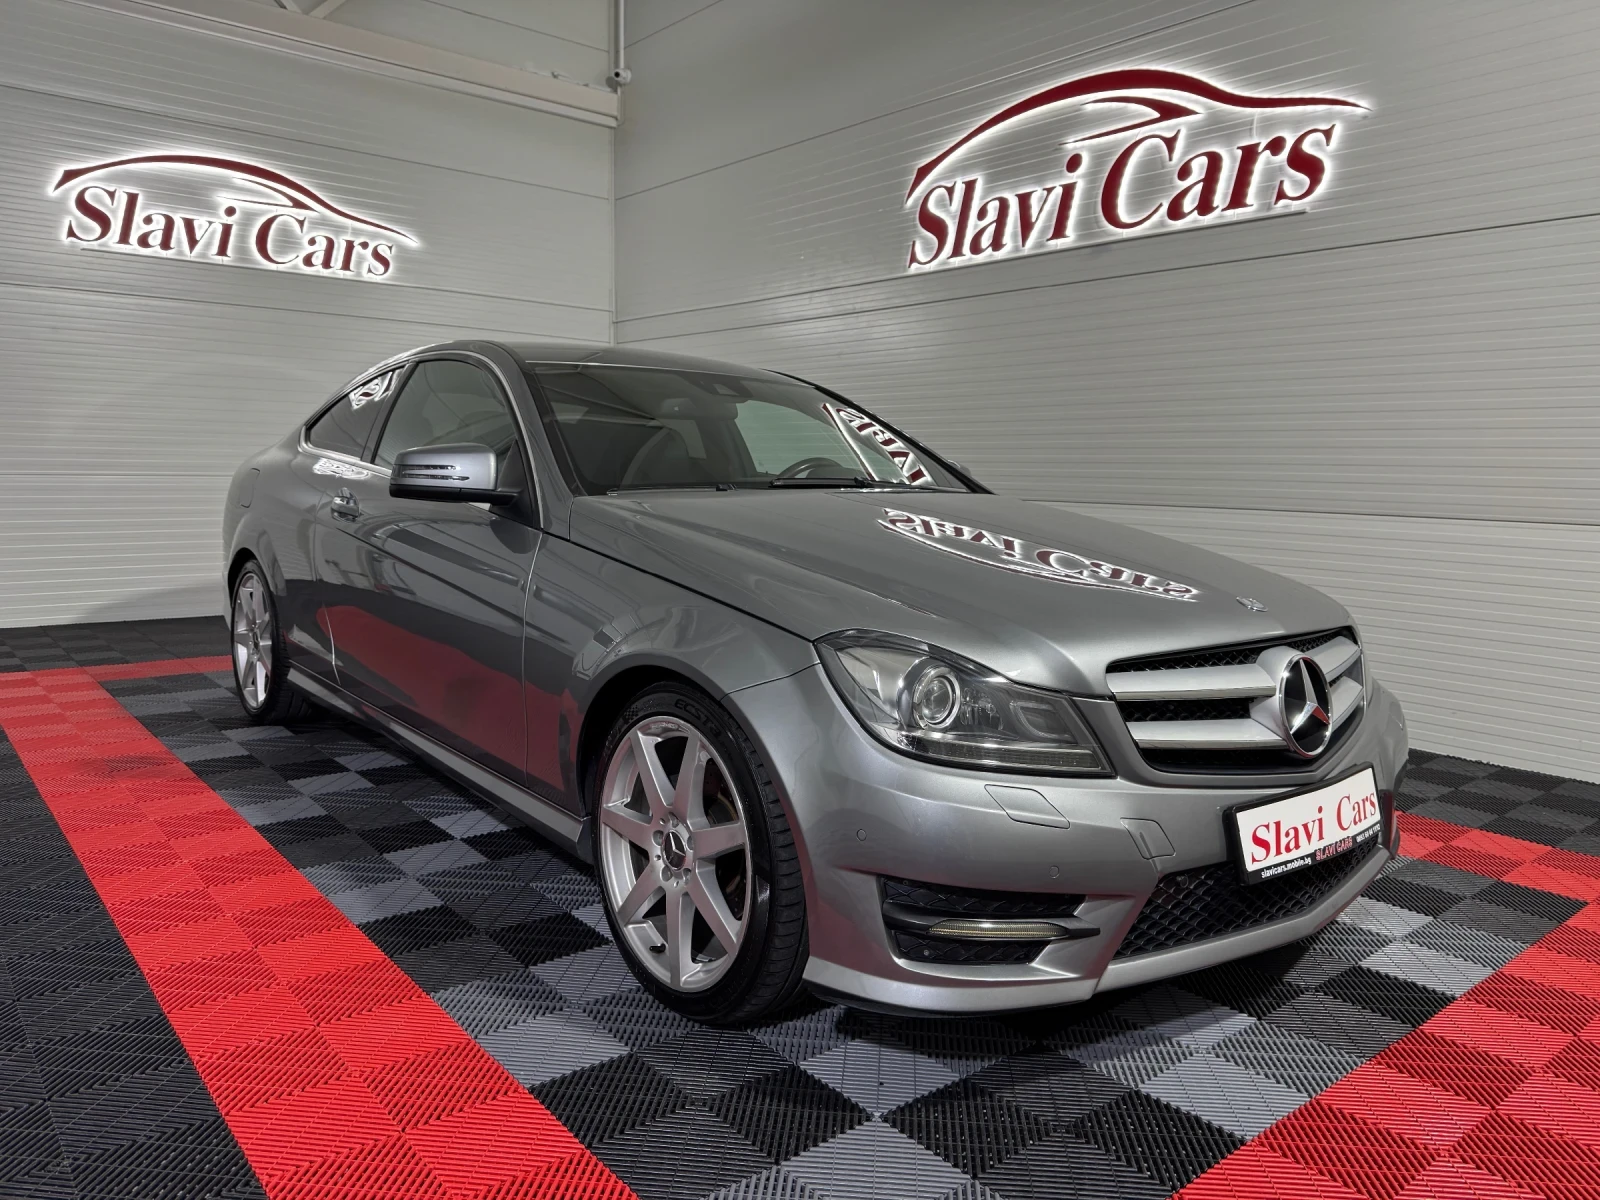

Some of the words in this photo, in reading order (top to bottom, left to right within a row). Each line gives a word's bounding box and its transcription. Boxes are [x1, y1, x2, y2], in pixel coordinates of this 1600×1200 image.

[66, 186, 237, 258] Slavi
[255, 214, 394, 276] Cars
[908, 153, 1083, 268] Slavi
[1101, 124, 1336, 229] Cars
[1251, 805, 1325, 865] Slavi
[1336, 792, 1377, 832] Cars
[1315, 844, 1336, 861] SLAVI
[1336, 836, 1353, 853] CARS
[1261, 856, 1312, 879] slavicars.mobile.bg
